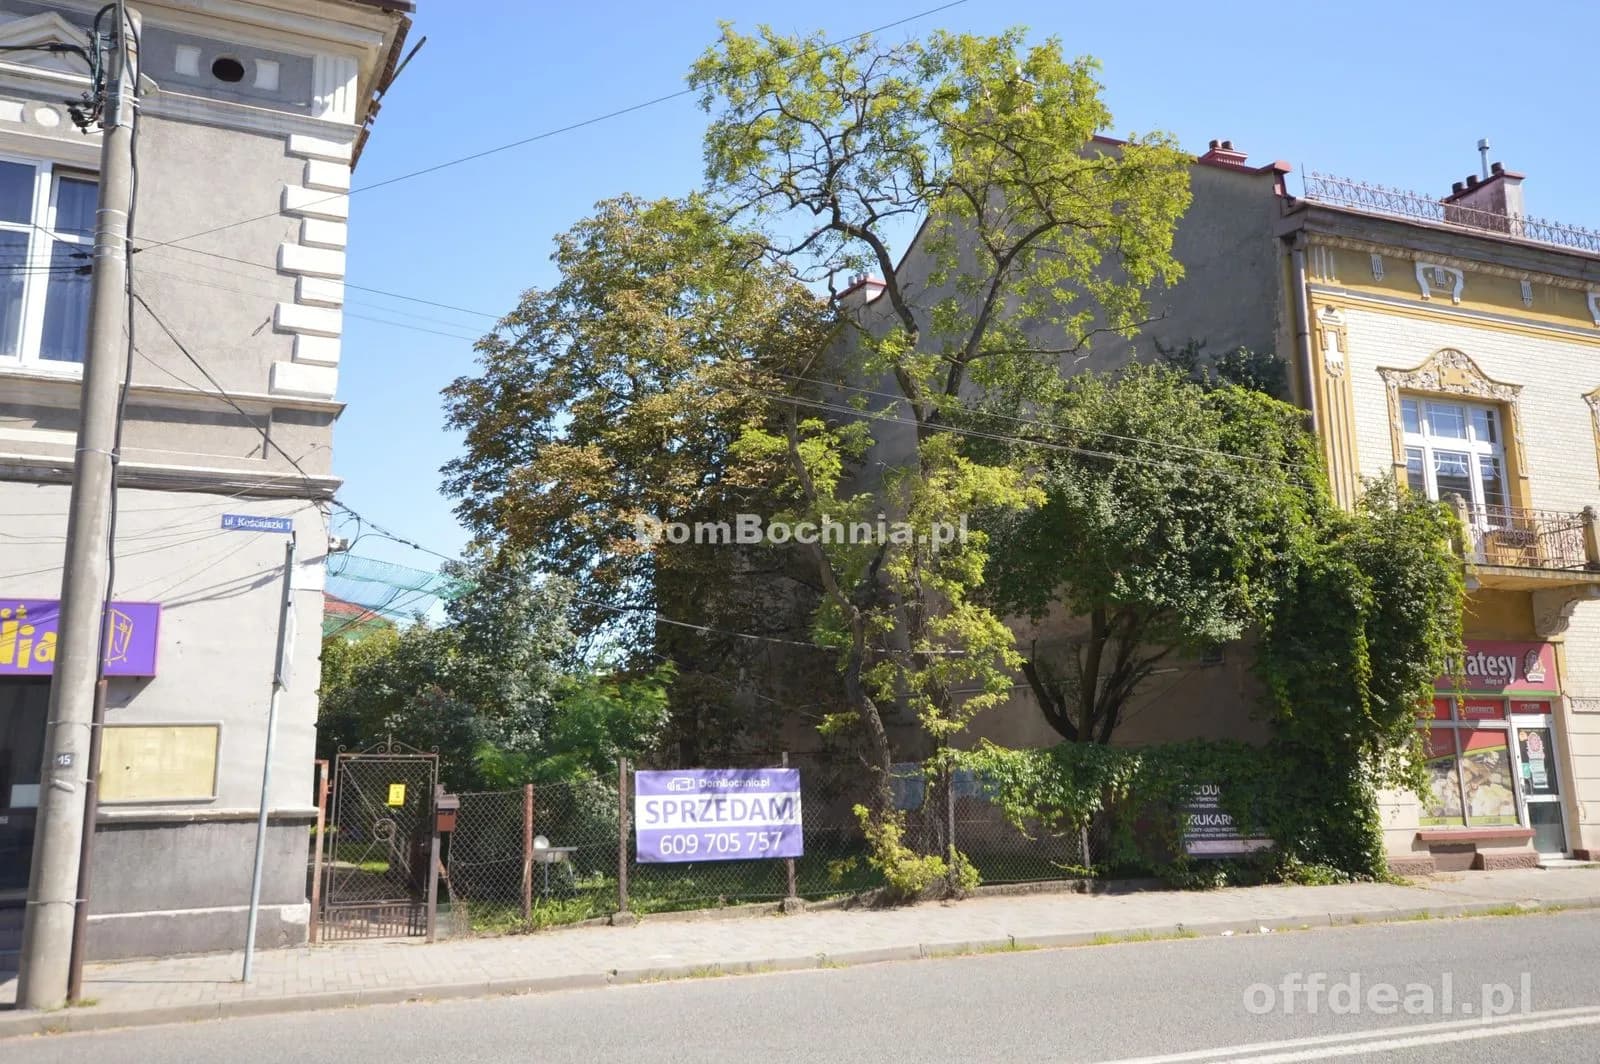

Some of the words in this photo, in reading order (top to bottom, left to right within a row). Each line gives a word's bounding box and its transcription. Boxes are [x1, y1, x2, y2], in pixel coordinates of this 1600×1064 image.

[58, 754, 71, 765] 15
[645, 796, 795, 825] SPRZEDAM
[659, 834, 699, 855] 609
[704, 832, 742, 854] 705
[746, 831, 783, 851] 757
